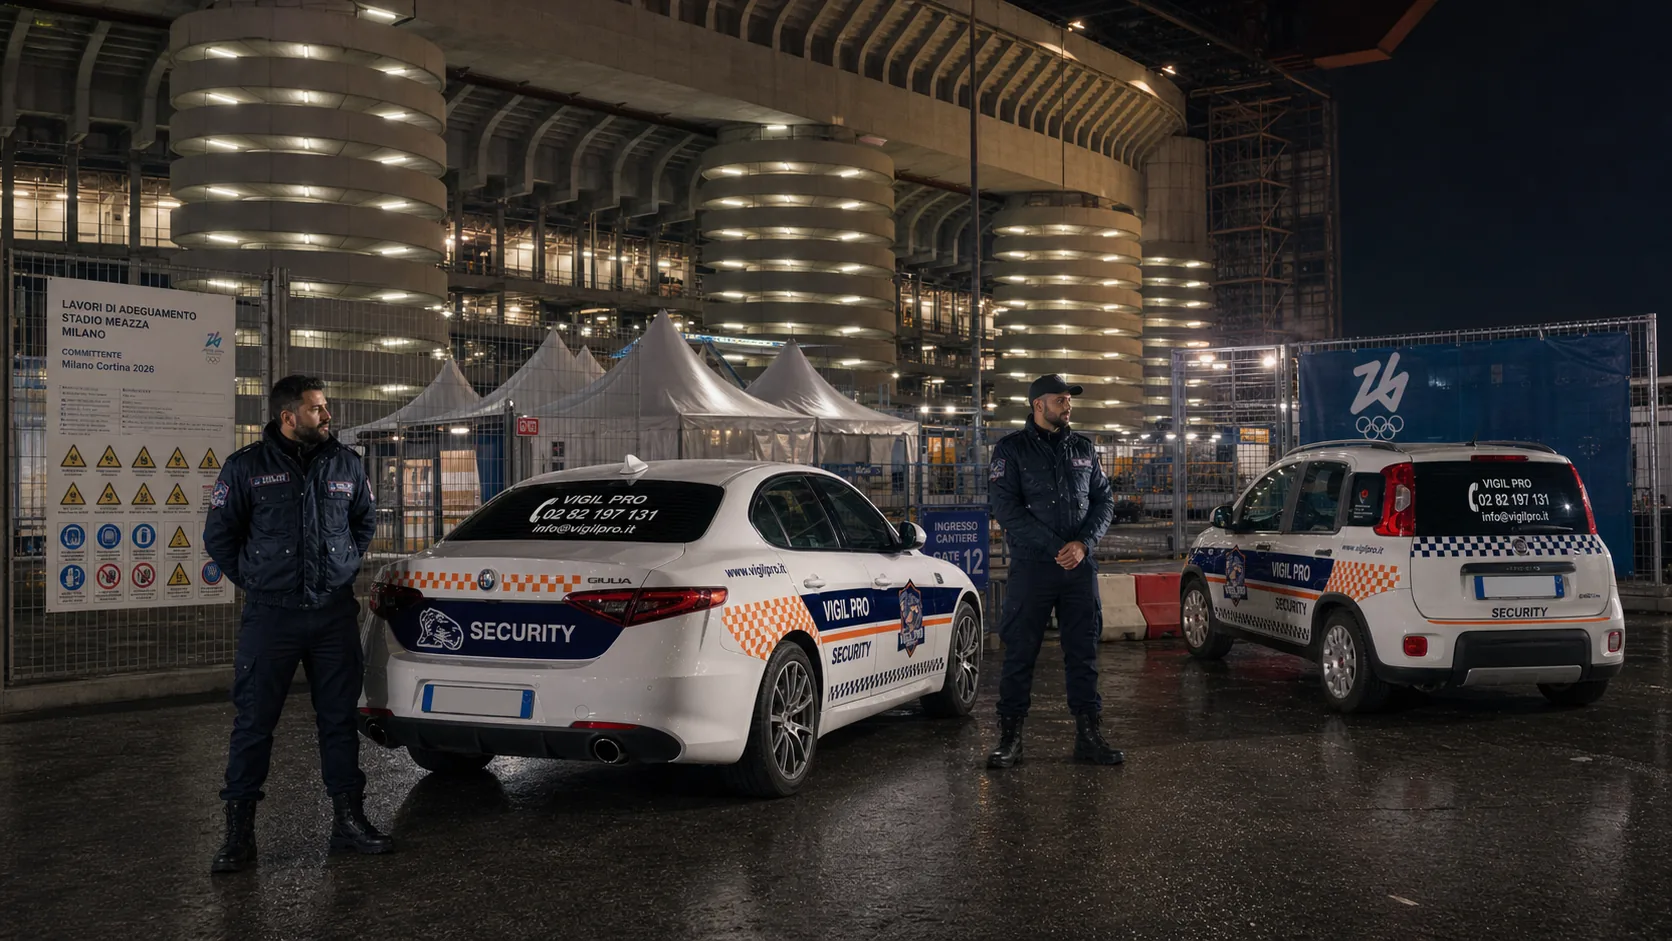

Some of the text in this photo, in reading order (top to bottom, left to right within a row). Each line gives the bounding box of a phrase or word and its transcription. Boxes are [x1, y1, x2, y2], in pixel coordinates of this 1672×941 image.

[62, 300, 197, 321] LAVORI DI ADEGUAMENTO
[62, 313, 150, 329] STADIO MEAZZA
[62, 327, 106, 339] MILANO
[62, 348, 122, 359] COMMITTENTE
[62, 360, 155, 373] Milano Cortina 2026
[1482, 479, 1532, 489] VIGIL PRO
[563, 495, 648, 505] VIGIL PRO
[1478, 494, 1550, 506] 02 82 197 131
[542, 509, 659, 521] 02 82 197 131
[1482, 511, 1549, 523] info@vigilpro.it
[532, 524, 636, 535] info@vigilpro.it
[934, 521, 978, 531] INGRESSO
[936, 534, 978, 544] CANTIERE
[964, 548, 984, 574] 12
[725, 562, 787, 579] www.vigilpro.it
[1272, 561, 1311, 582] VIGIL PRO
[823, 597, 870, 623] VIGIL PRO
[1275, 597, 1307, 615] SECURITY
[1492, 607, 1548, 618] SECURITY
[470, 621, 576, 643] SECURITY
[832, 641, 872, 665] SECURITY
